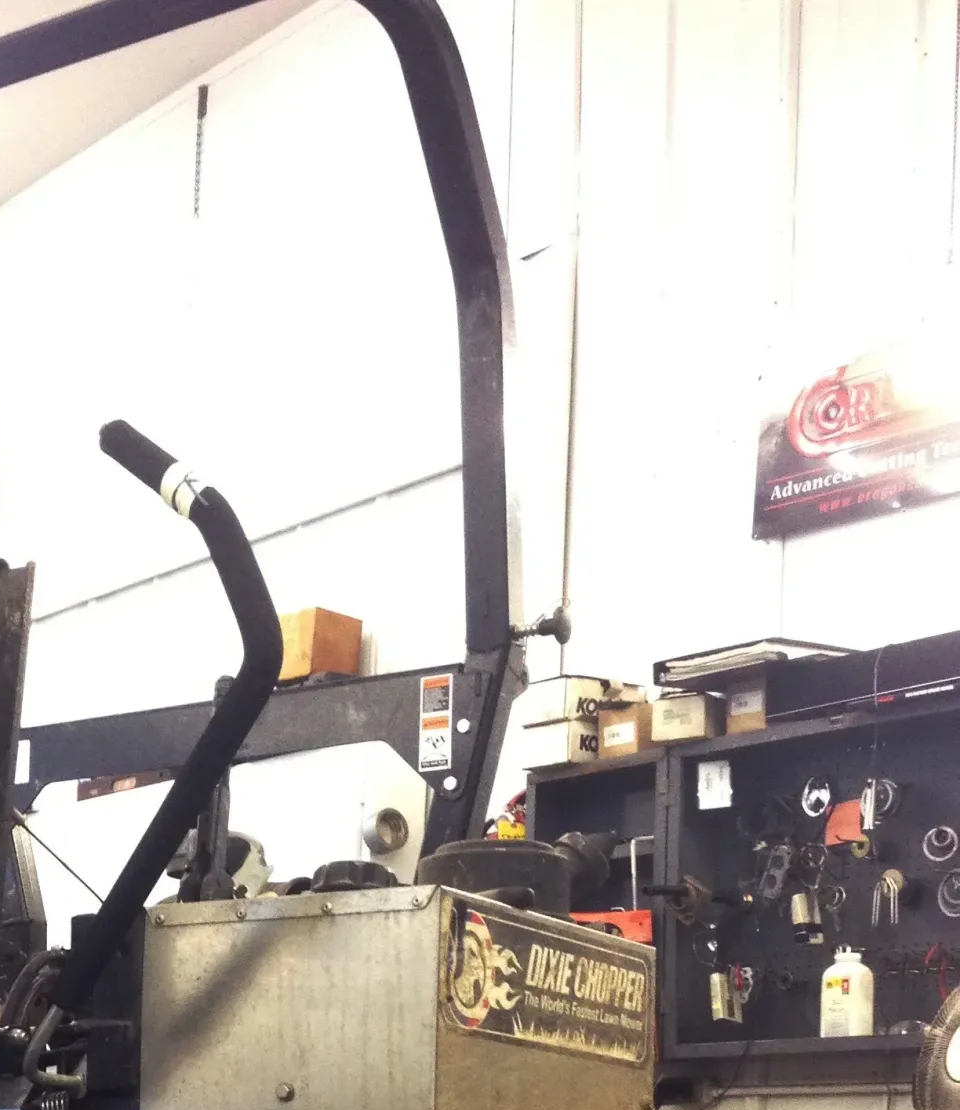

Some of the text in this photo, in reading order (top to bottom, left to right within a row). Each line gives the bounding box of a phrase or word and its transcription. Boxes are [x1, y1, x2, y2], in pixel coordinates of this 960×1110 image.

[576, 697, 600, 716] KO
[525, 944, 645, 1012] DIXIE CHOPPER
[524, 990, 539, 1008] The
